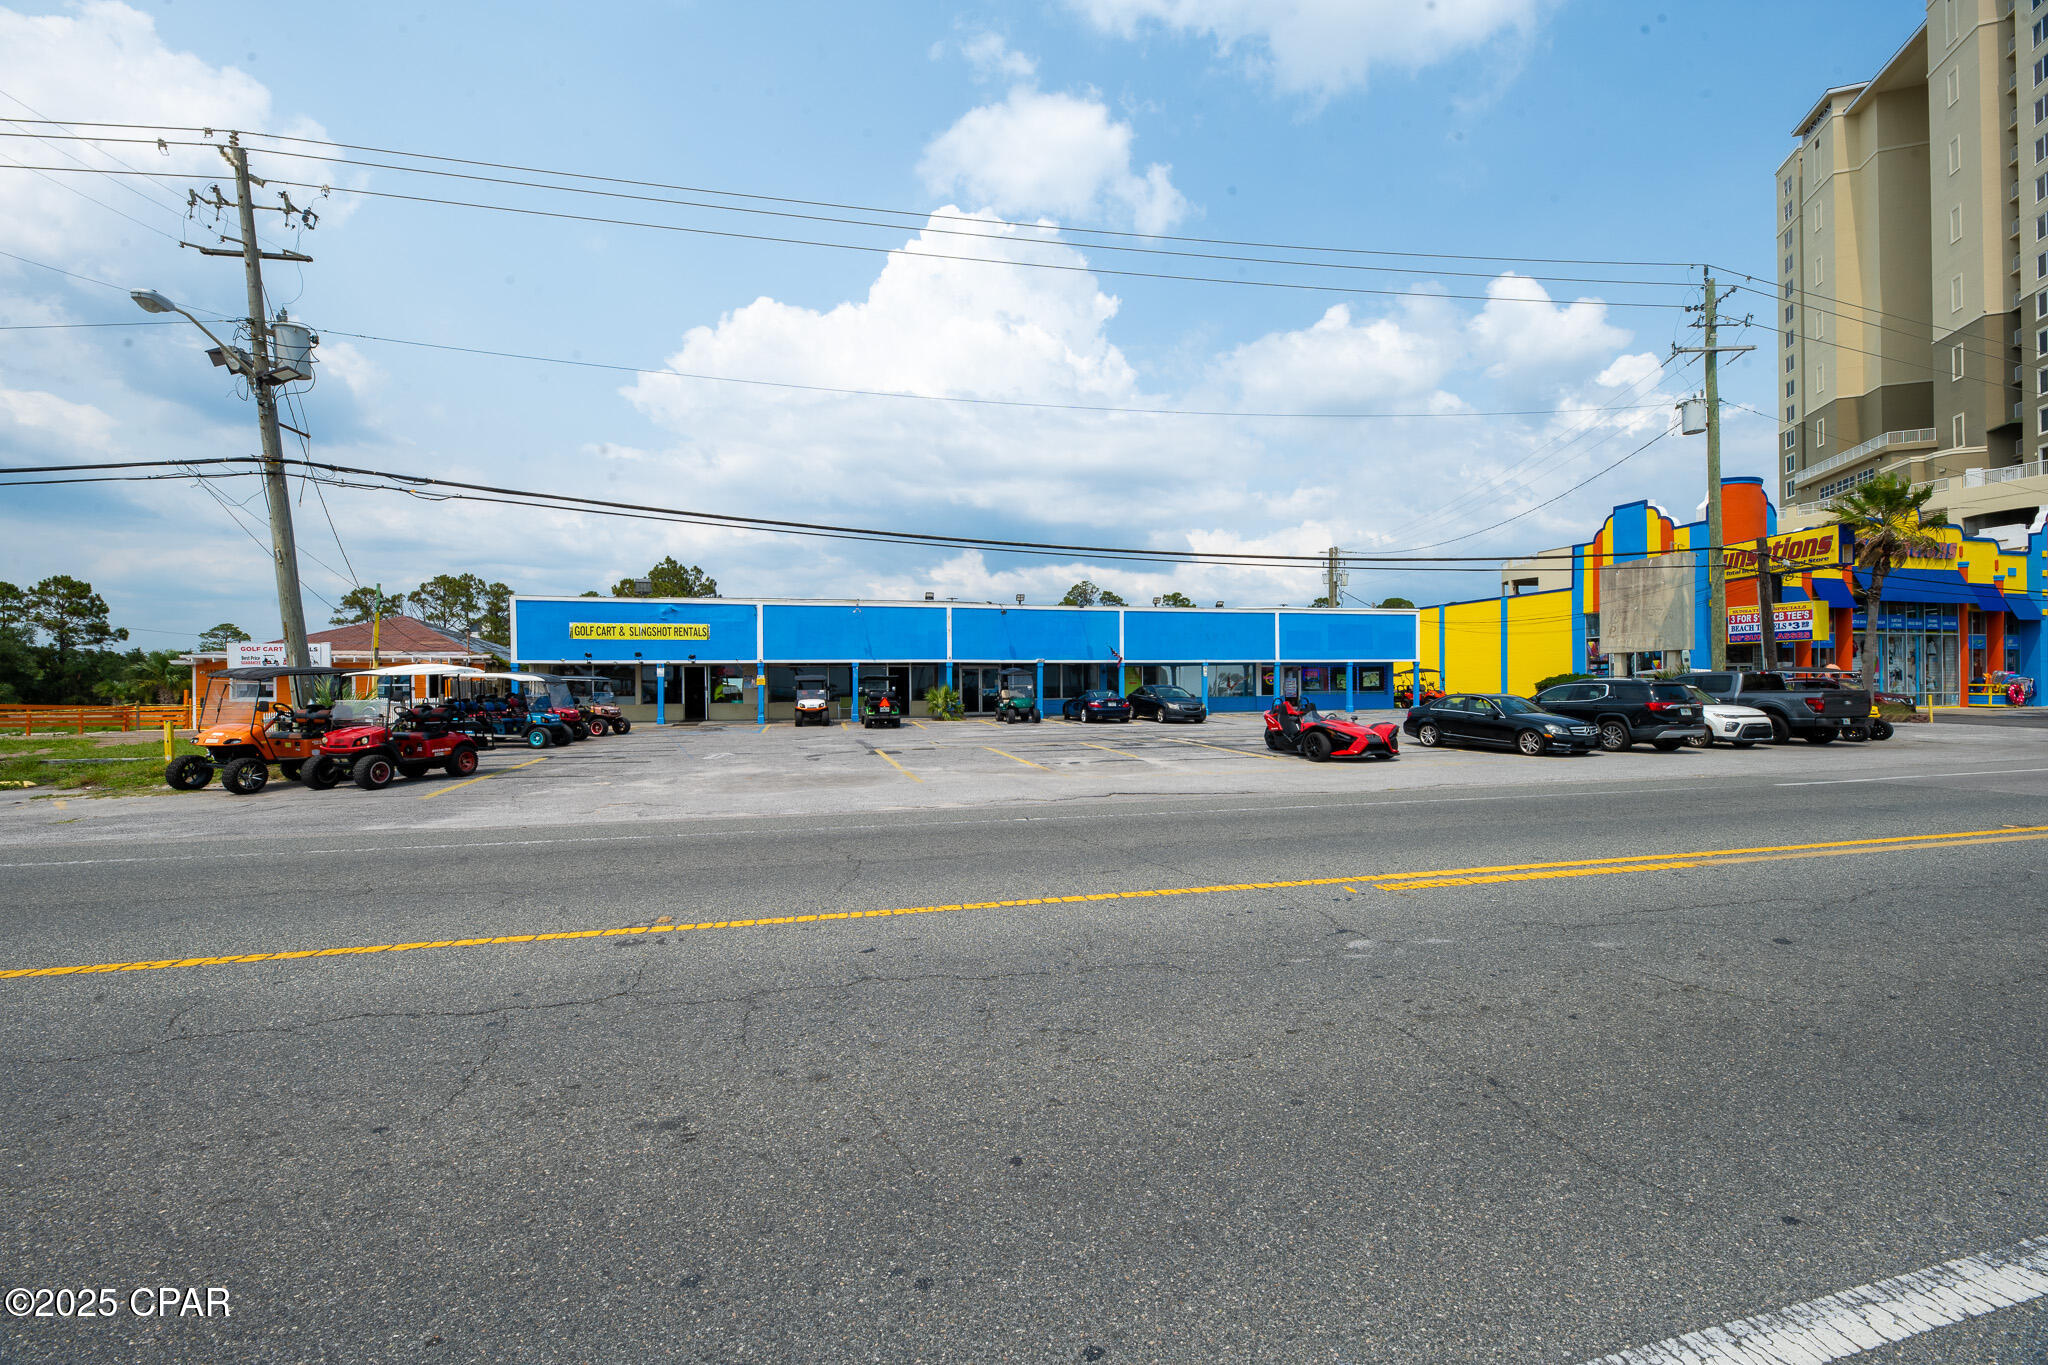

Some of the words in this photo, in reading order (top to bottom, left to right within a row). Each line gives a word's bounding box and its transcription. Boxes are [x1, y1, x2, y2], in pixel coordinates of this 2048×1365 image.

[1730, 615, 1736, 623] 3
[1737, 614, 1751, 623] FOR
[1786, 610, 1810, 620] TEE'S
[574, 625, 594, 636] GOLF
[595, 625, 617, 636] CART
[618, 626, 626, 637] &
[629, 626, 672, 637] SLINGSHOT
[673, 626, 707, 637] RENTALS
[1731, 624, 1754, 632] BEACH
